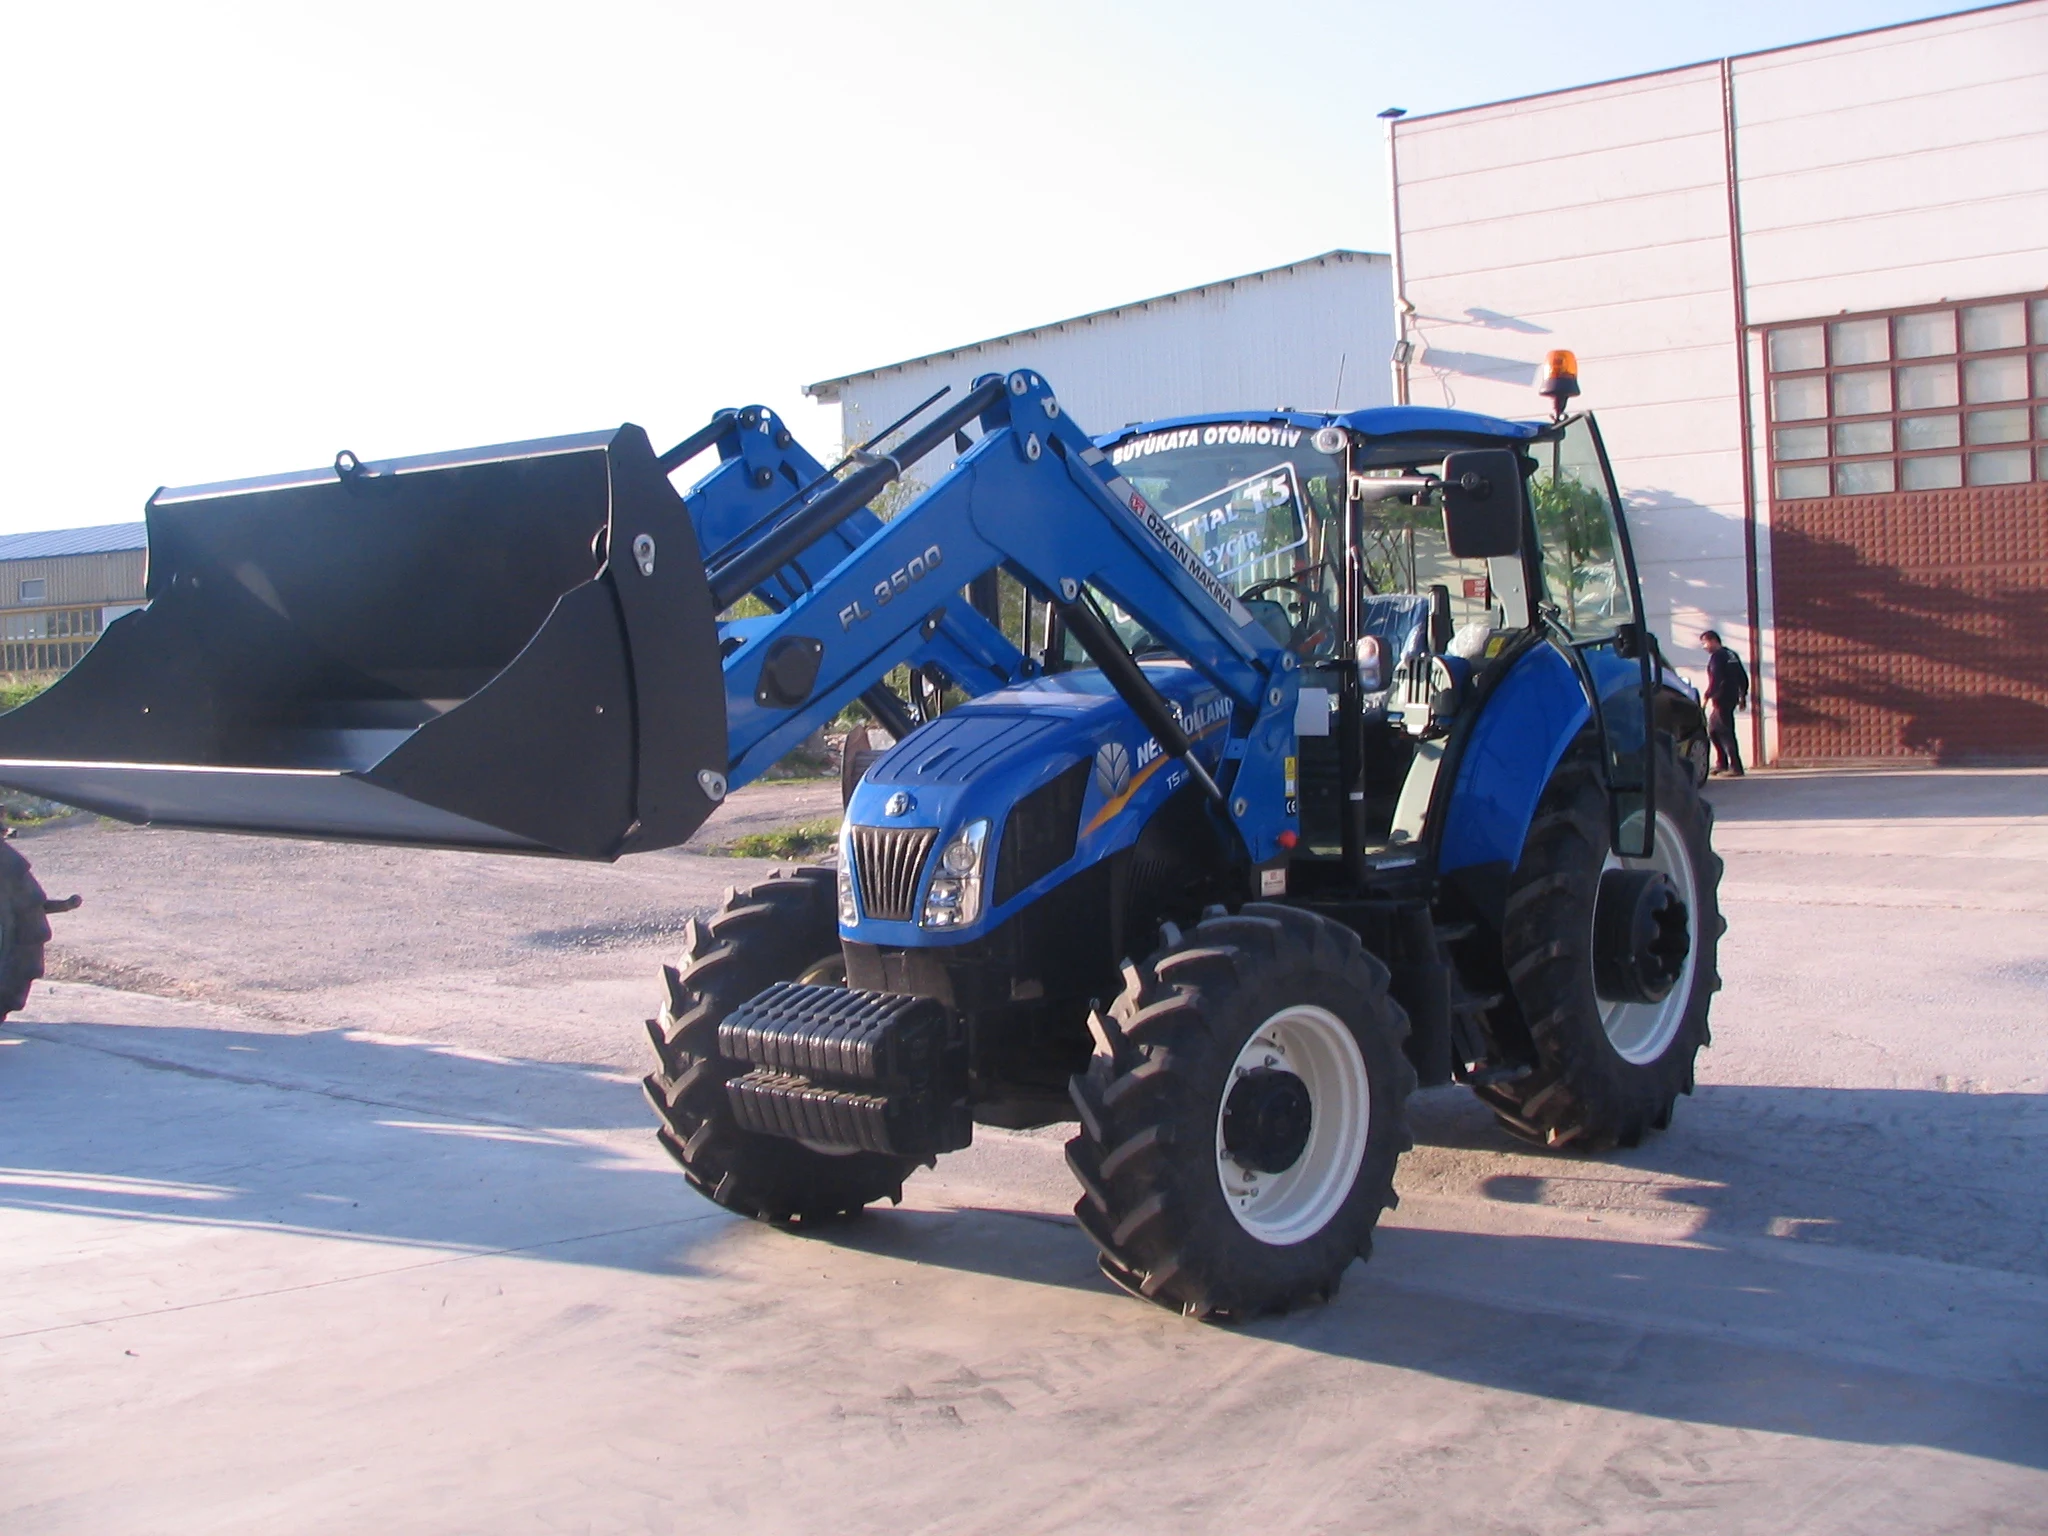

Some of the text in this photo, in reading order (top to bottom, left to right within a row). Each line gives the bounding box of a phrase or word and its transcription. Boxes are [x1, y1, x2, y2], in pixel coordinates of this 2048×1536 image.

[1203, 424, 1302, 448] OTOMOTİV
[838, 544, 943, 633] FL 3500
[1146, 513, 1232, 613] ÖZKAN MAKİNA
[1136, 737, 1164, 769] NE
